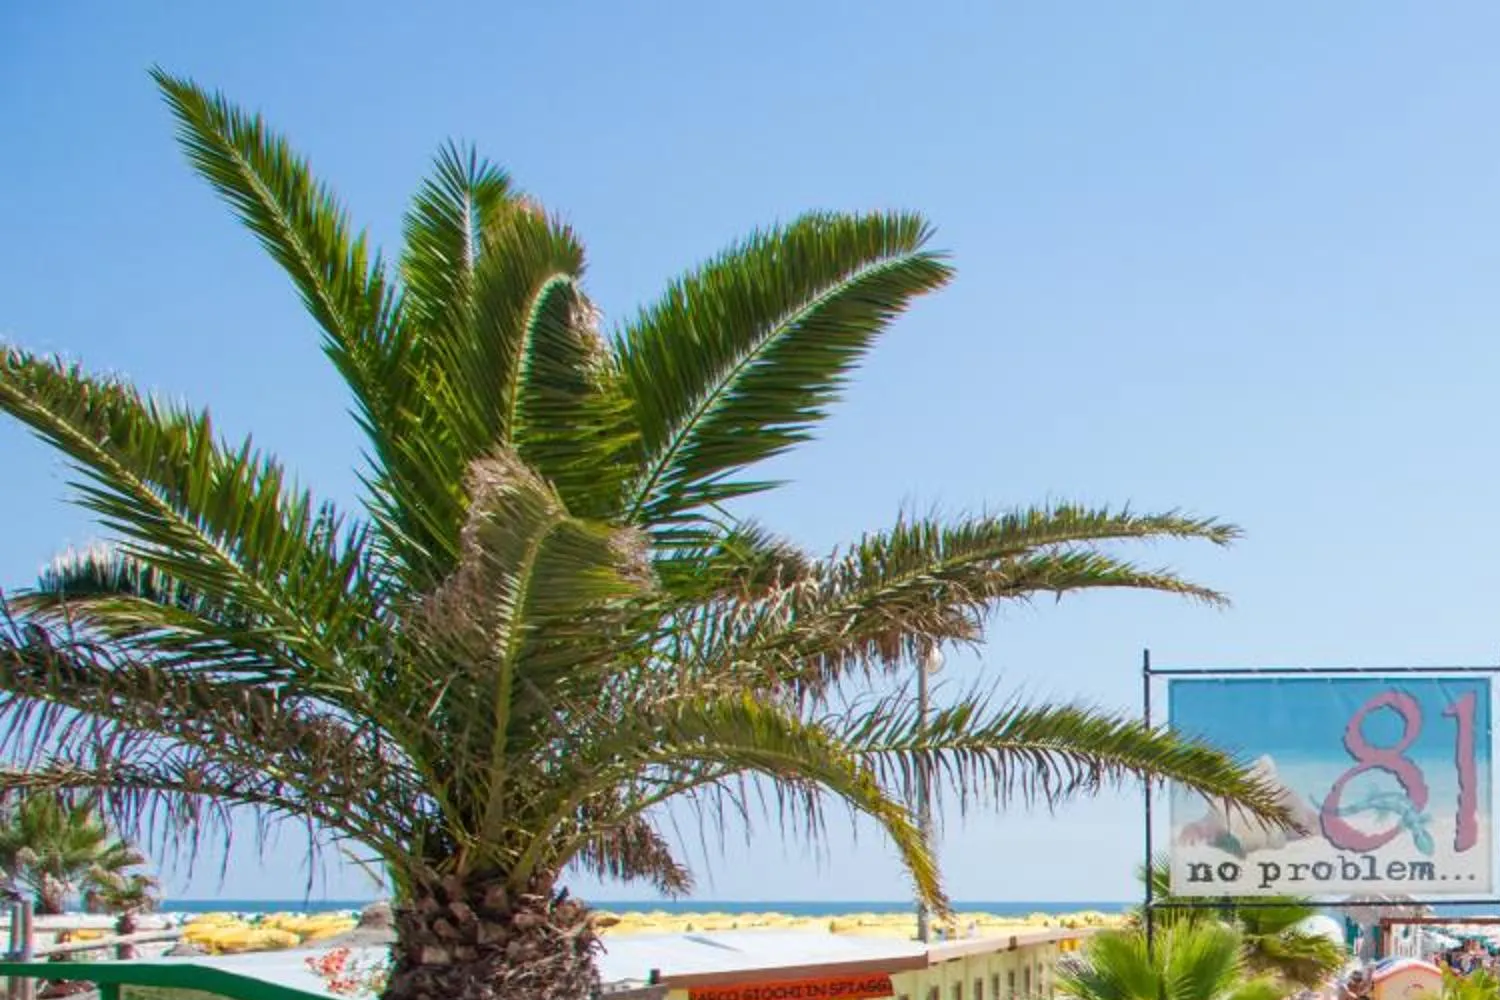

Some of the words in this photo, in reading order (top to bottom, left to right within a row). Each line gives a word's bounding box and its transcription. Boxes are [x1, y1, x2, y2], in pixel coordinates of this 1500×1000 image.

[1319, 687, 1479, 855] 81
[1186, 860, 1240, 883] no
[1257, 855, 1477, 889] problem...
